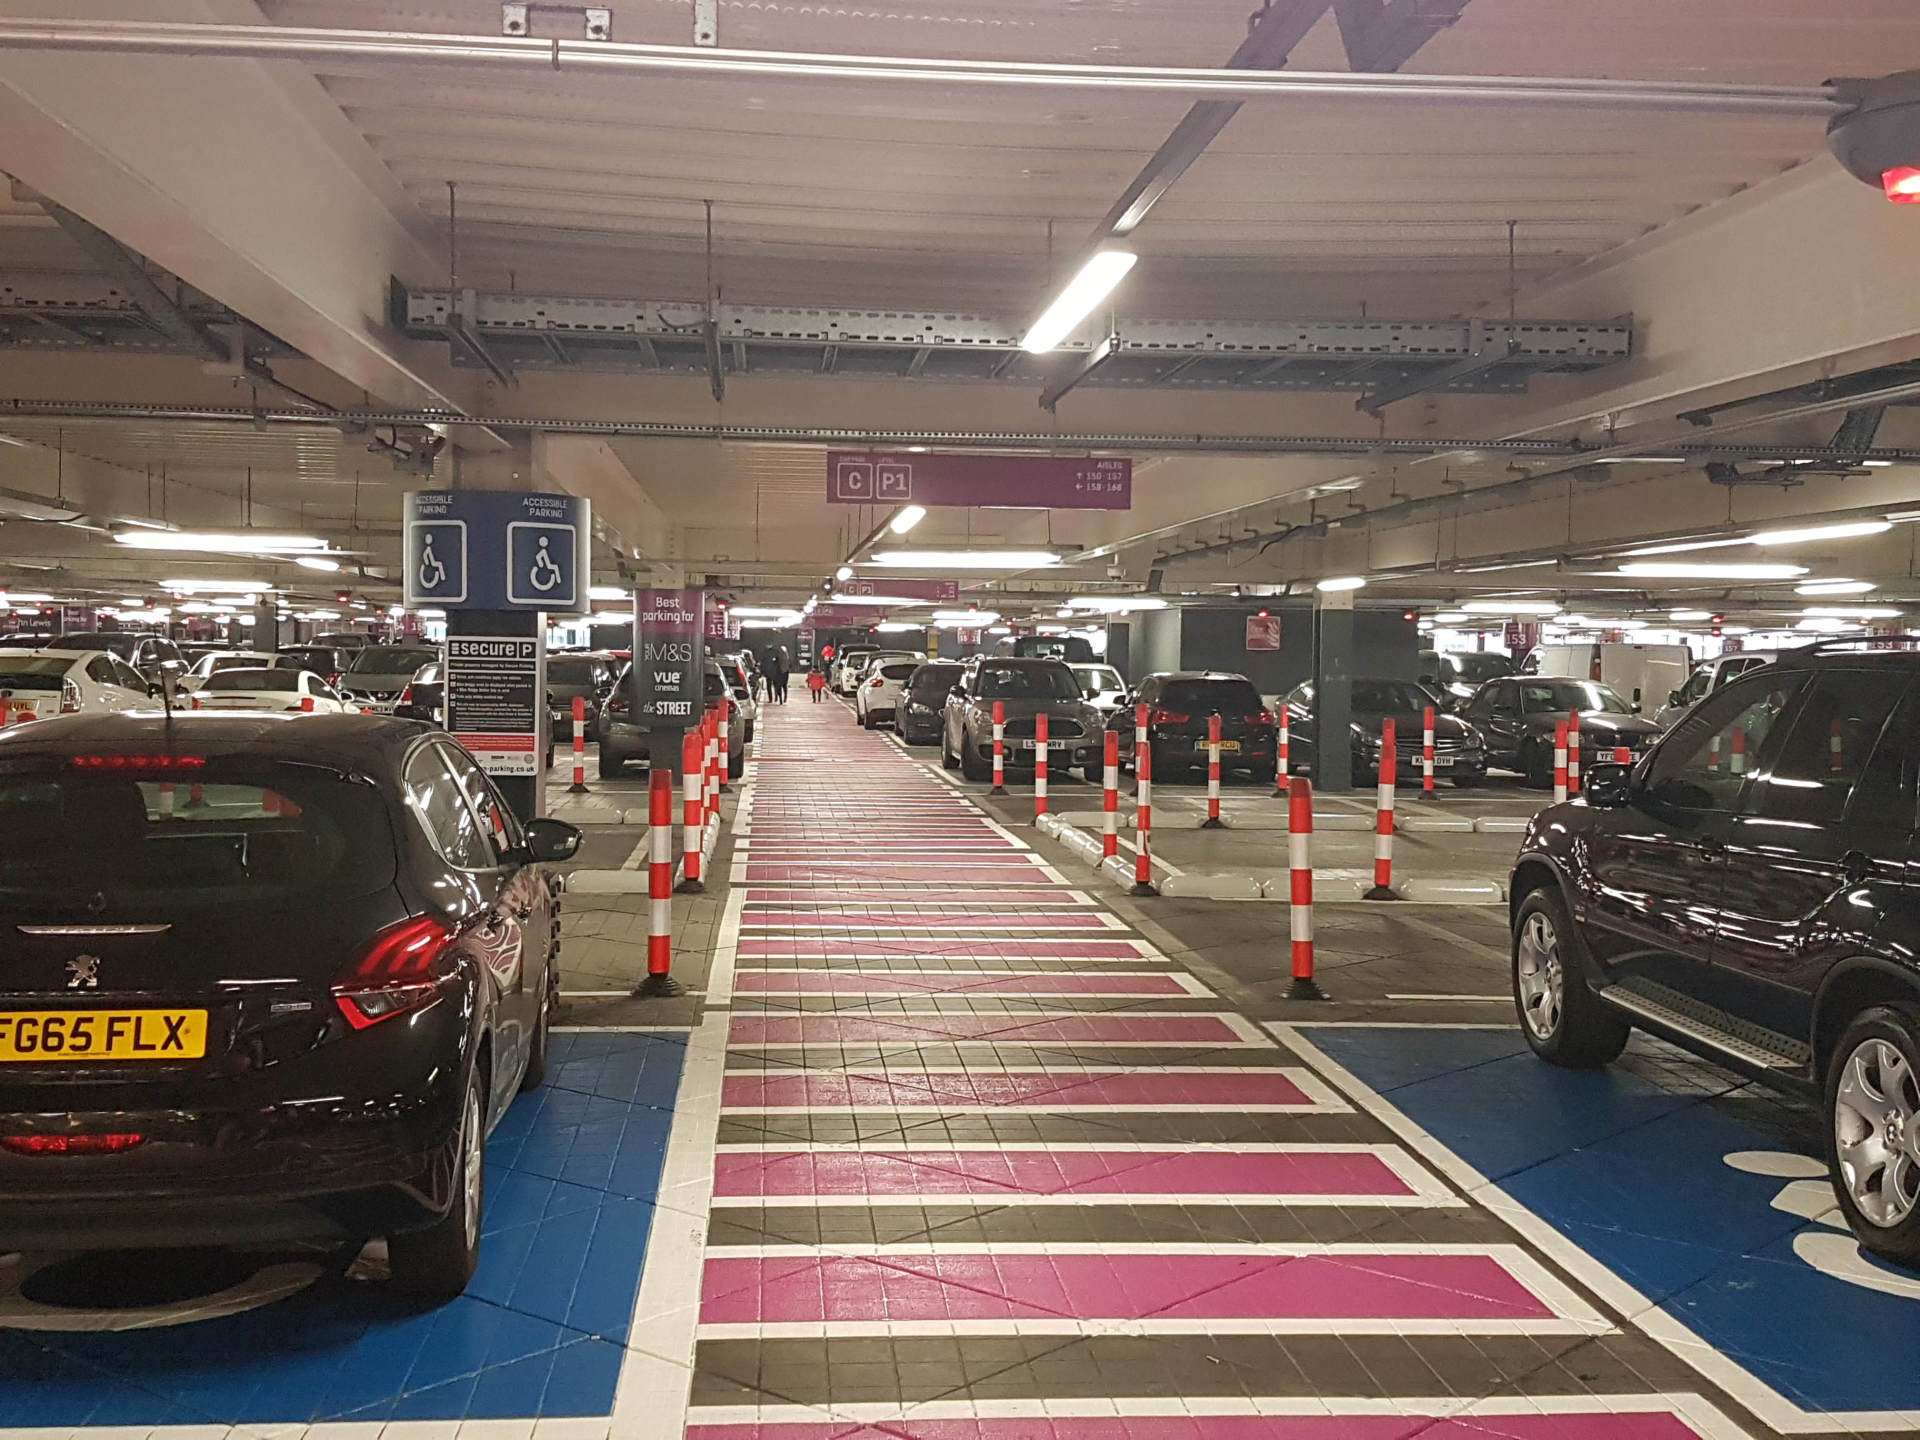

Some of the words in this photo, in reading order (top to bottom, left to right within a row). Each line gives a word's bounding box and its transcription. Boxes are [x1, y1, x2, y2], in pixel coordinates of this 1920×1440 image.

[848, 471, 861, 489] C
[882, 472, 907, 490] P1
[416, 495, 453, 504] ACCESSIBLE
[522, 497, 568, 508] ACCESSIBLE
[418, 505, 447, 514] PARKING
[529, 507, 563, 518] PARKING
[655, 597, 680, 608] Best
[642, 610, 680, 624] parking
[681, 610, 694, 622] for
[460, 643, 515, 656] secure
[522, 644, 532, 657] P
[650, 643, 692, 662] M&S
[653, 671, 681, 683] vue
[656, 701, 692, 715] STREET
[105, 1016, 187, 1051] FLX
